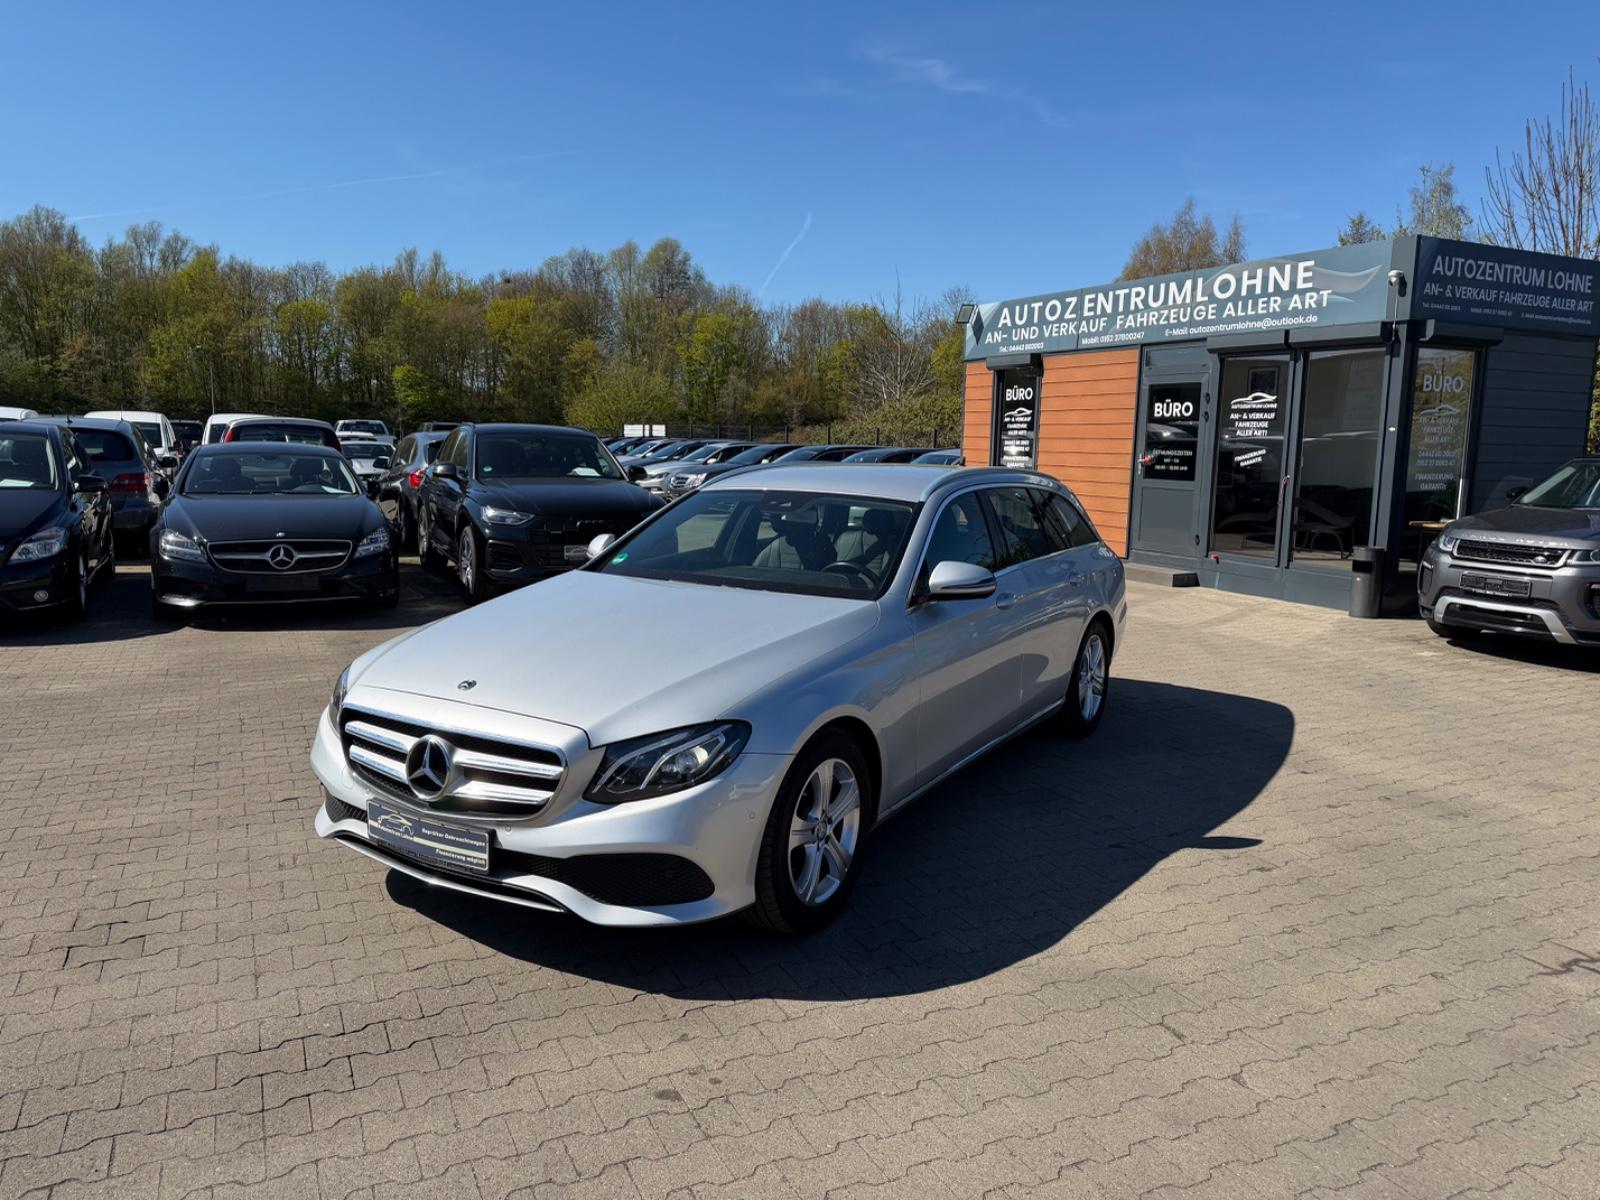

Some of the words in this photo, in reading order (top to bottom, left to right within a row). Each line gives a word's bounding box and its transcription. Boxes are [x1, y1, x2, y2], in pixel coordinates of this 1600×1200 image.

[1432, 255, 1545, 288] AUTOZENTRUM
[1548, 270, 1593, 293] LOHNE
[1424, 282, 1443, 296] AN-
[1445, 285, 1453, 297] &
[1455, 286, 1498, 301] VERKAUF
[1500, 290, 1550, 309] FAHRZEUGE
[1552, 297, 1575, 311] ALLER
[1577, 300, 1594, 313] ART
[985, 330, 1008, 345] AN-
[1012, 326, 1039, 341] UND
[1043, 317, 1108, 338] VERKAUF
[1116, 304, 1218, 330] FAHRZEUGE
[1223, 296, 1281, 318] ALLER
[1288, 290, 1332, 311] ART
[1189, 314, 1318, 335] autozentrumlohne@outlook.de
[1423, 370, 1464, 392] BÜRO
[1005, 385, 1033, 401] BÜRO
[1154, 399, 1193, 417] BÜRO
